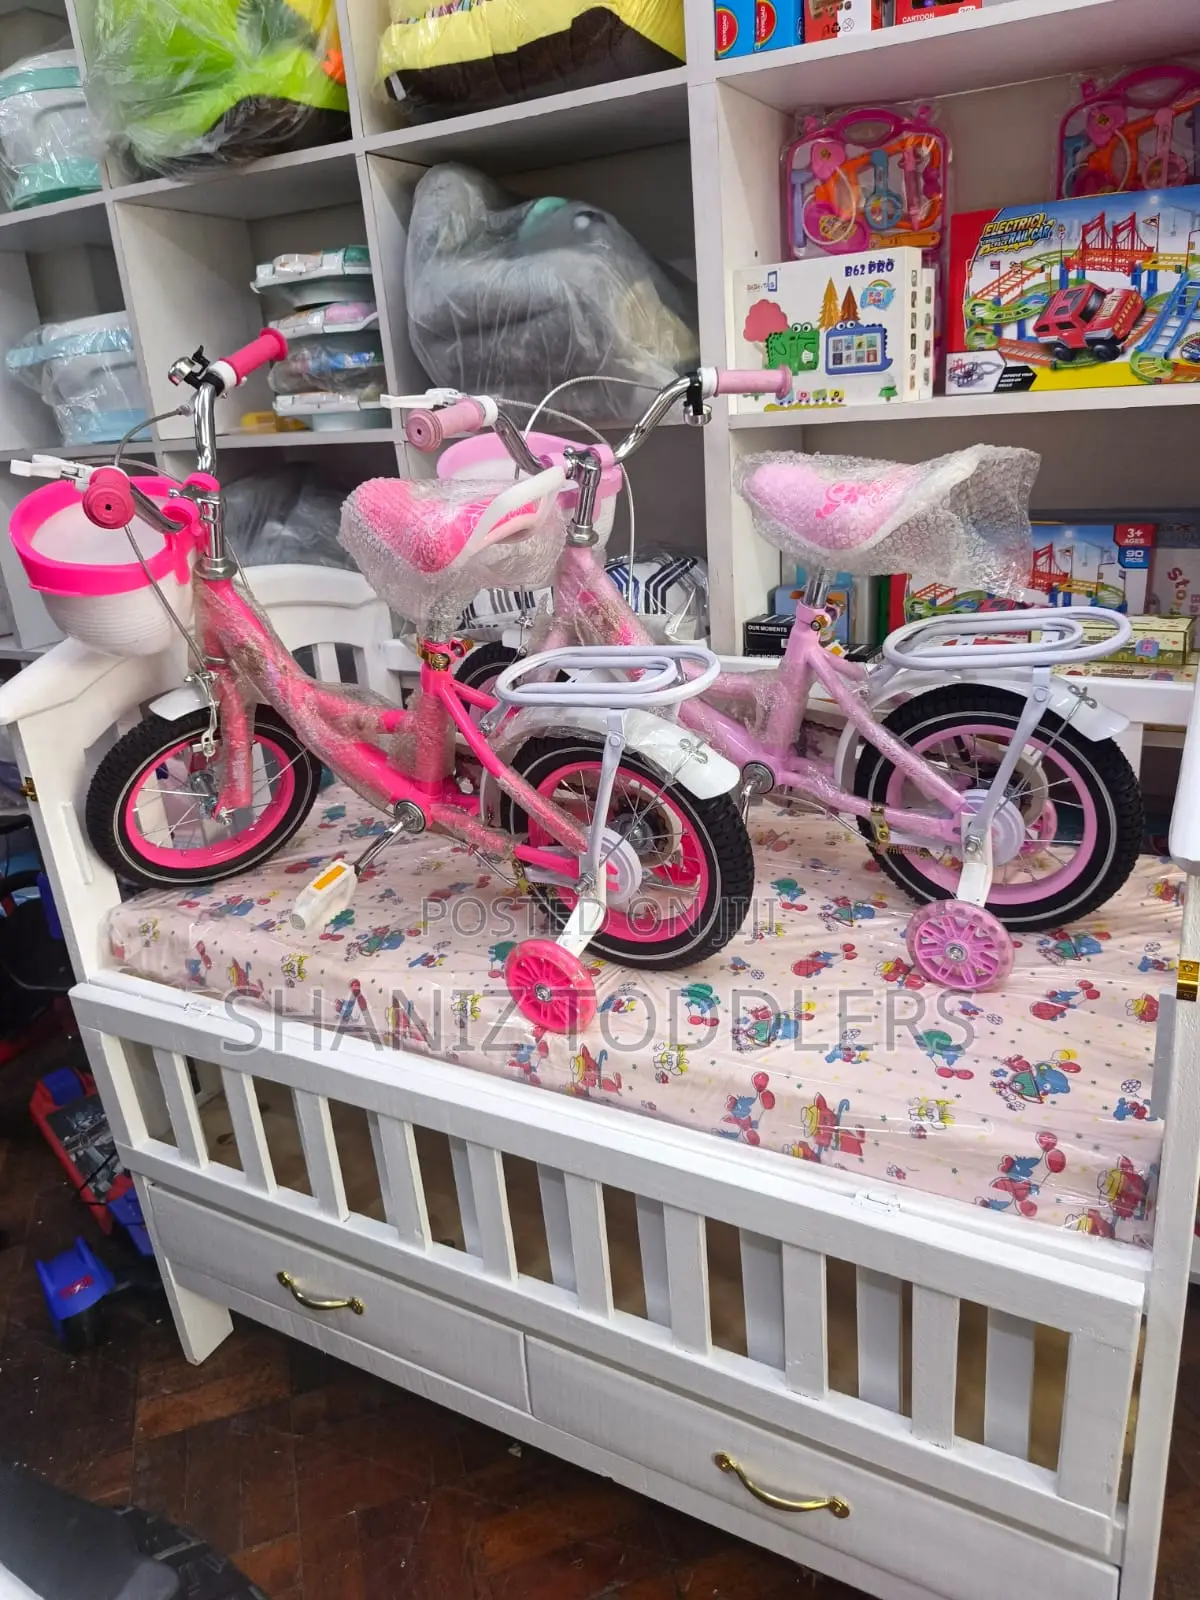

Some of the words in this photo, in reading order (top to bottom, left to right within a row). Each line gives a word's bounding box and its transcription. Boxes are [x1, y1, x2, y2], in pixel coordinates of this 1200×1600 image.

[1008, 229, 1028, 245] RAIL
[1031, 224, 1051, 241] CAR
[845, 264, 865, 277] B62
[868, 258, 895, 275] PRO
[1127, 528, 1144, 538] 3+
